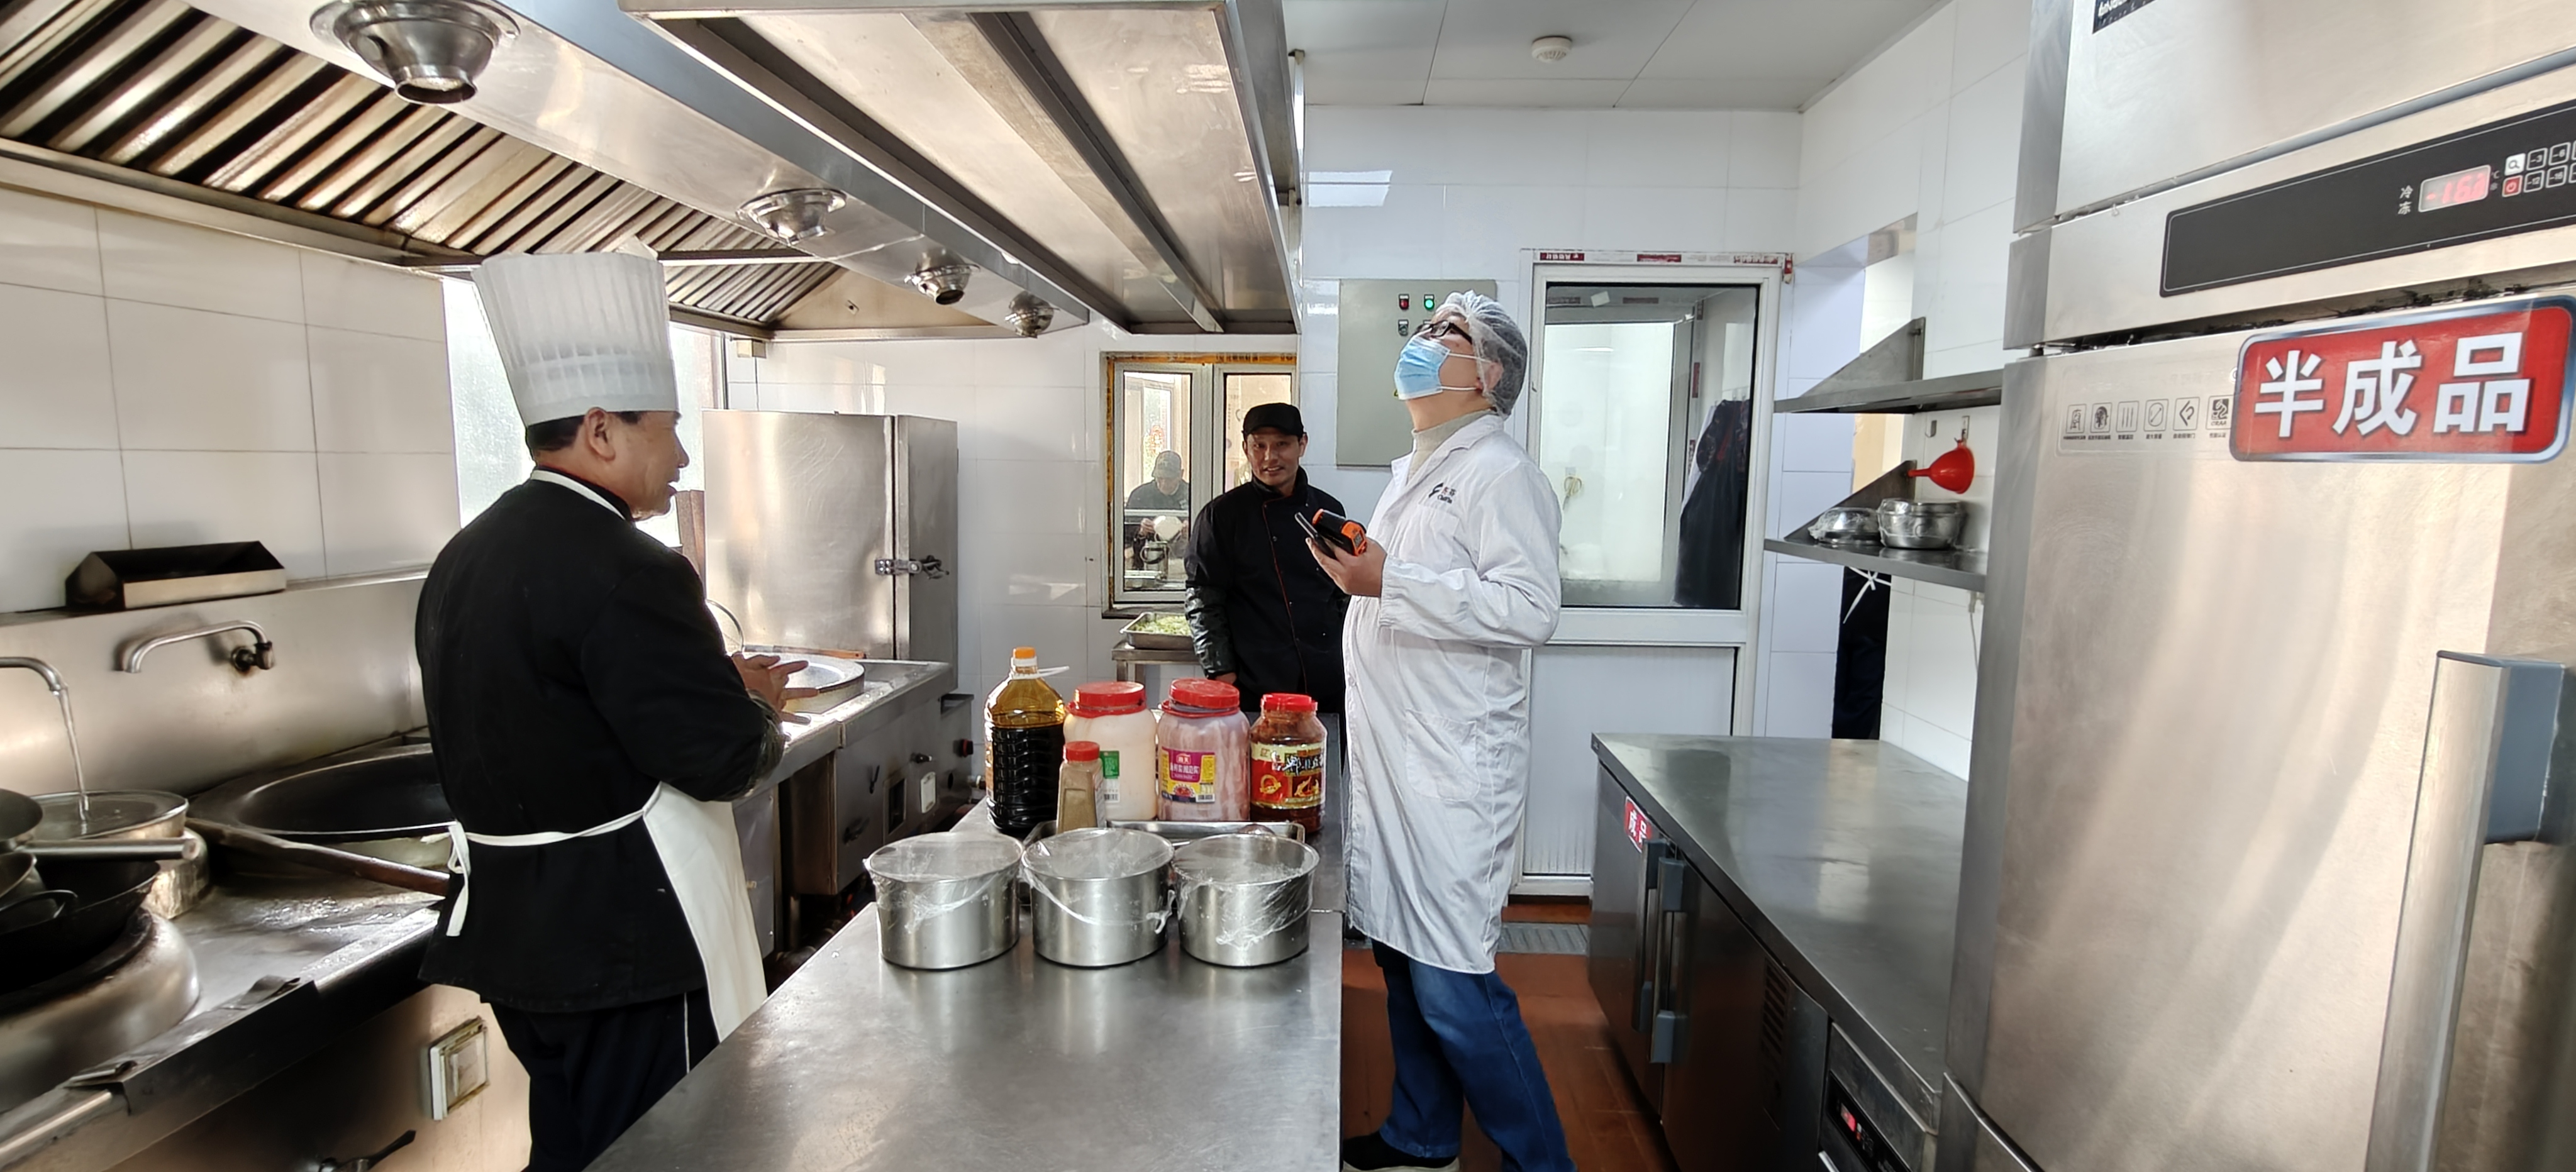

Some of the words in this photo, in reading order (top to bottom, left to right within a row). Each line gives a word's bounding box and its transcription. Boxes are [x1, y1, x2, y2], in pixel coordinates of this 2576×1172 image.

[2530, 155, 2543, 163] -3
[2553, 149, 2565, 158] -6
[2527, 177, 2540, 185] -12
[2550, 172, 2563, 180] -16
[2397, 185, 2413, 214] 冷冻
[2255, 332, 2531, 438] 半成品
